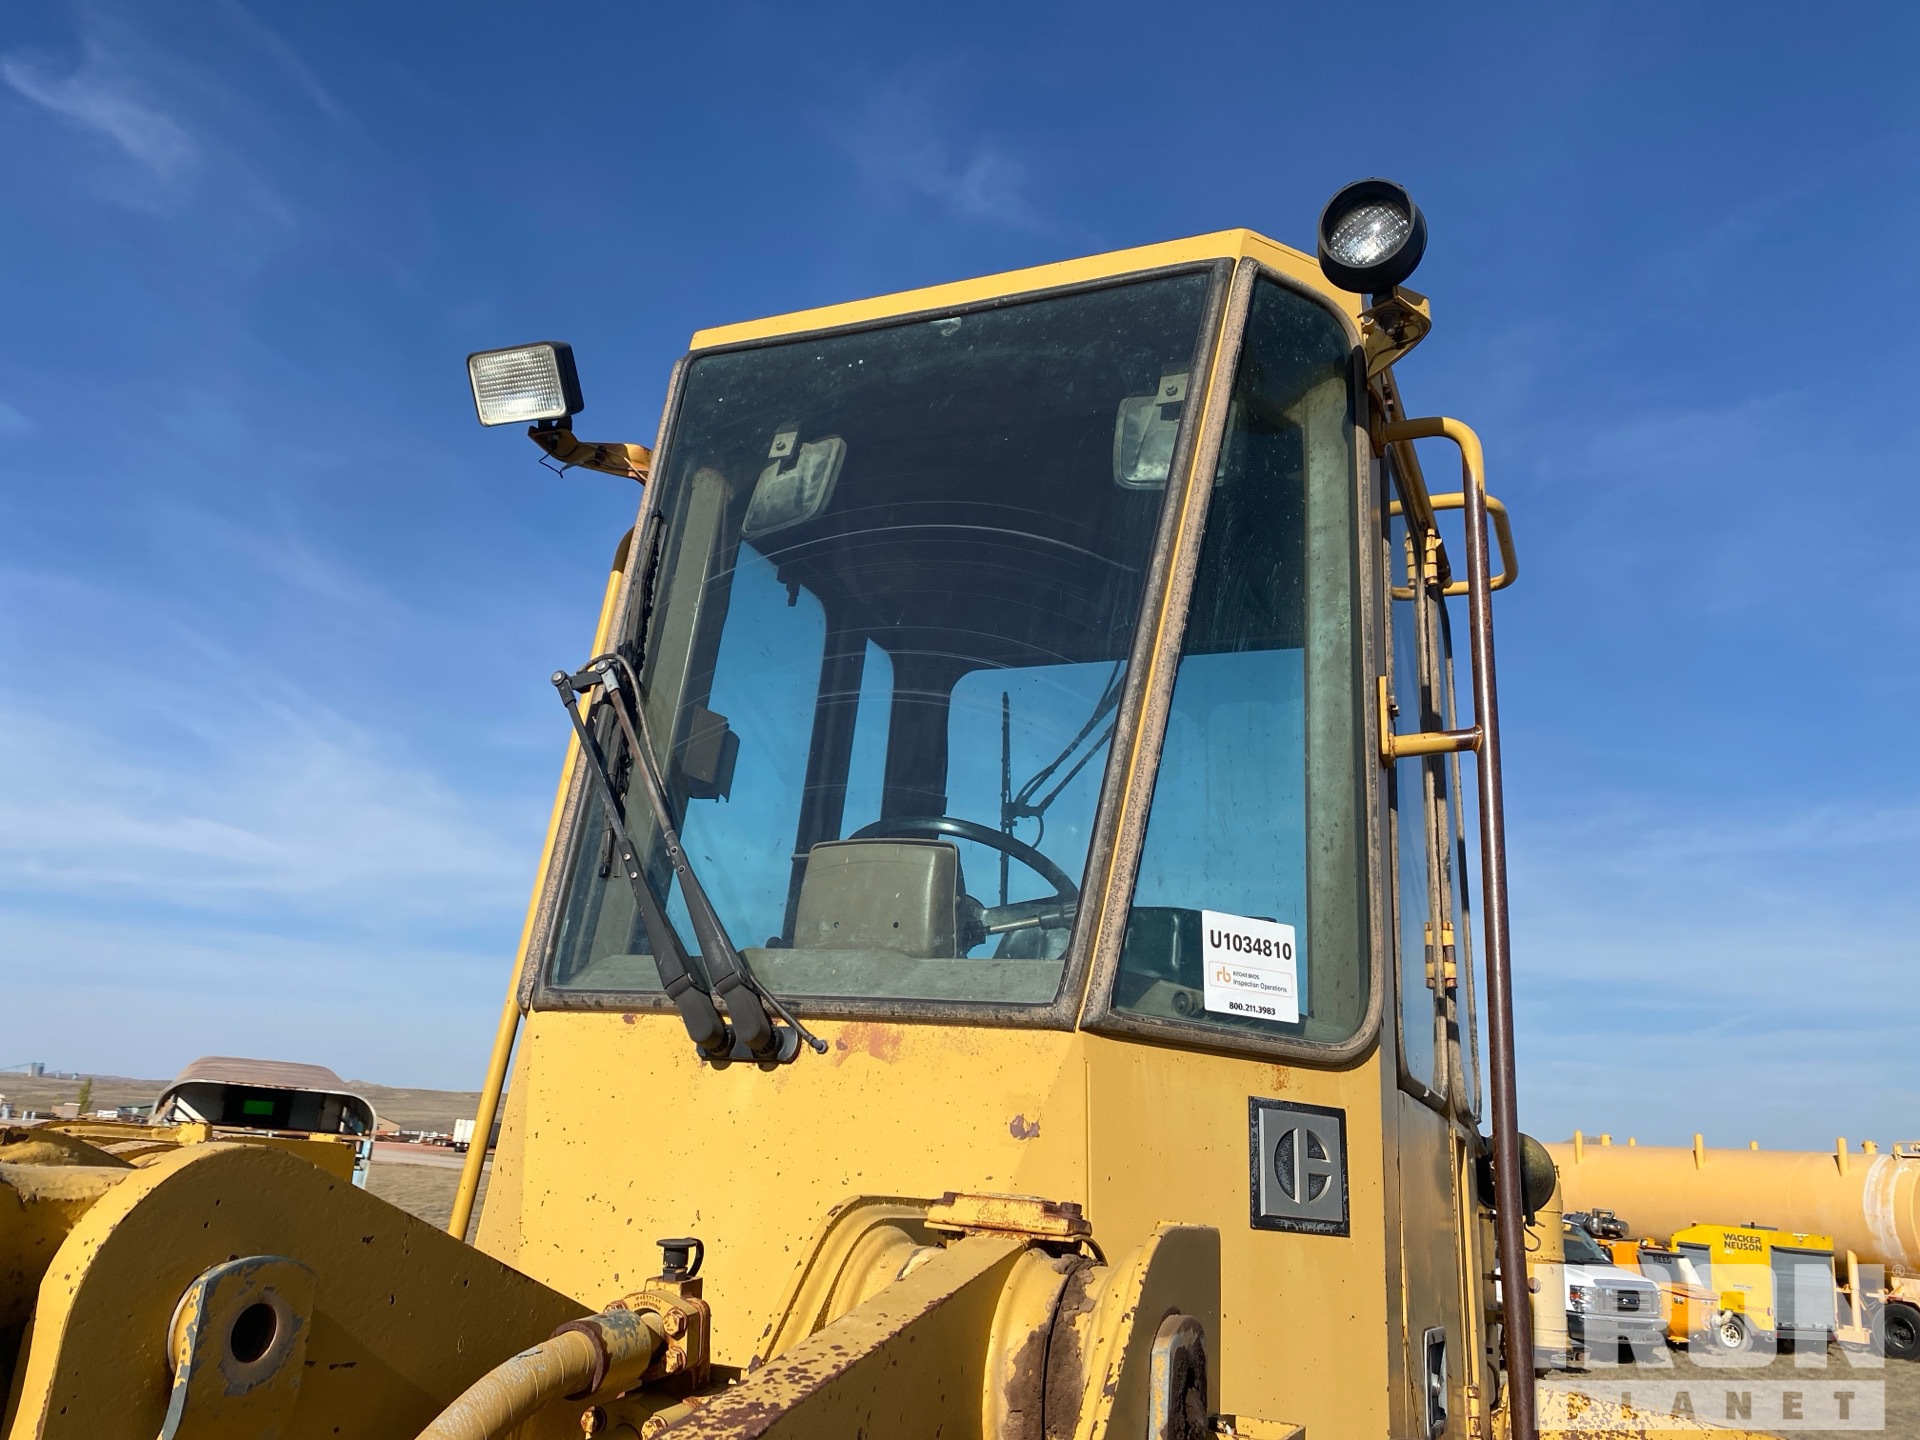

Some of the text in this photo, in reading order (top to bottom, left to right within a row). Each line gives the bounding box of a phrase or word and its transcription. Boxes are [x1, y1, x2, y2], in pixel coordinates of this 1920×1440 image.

[1210, 929, 1292, 960] U1034810
[1233, 979, 1288, 993] Inspection Operations
[1228, 1001, 1276, 1016] 800.211.3983
[1723, 1232, 1762, 1245] WACKER
[1724, 1240, 1763, 1253] NEUSON
[1652, 1254, 1672, 1265] REED
